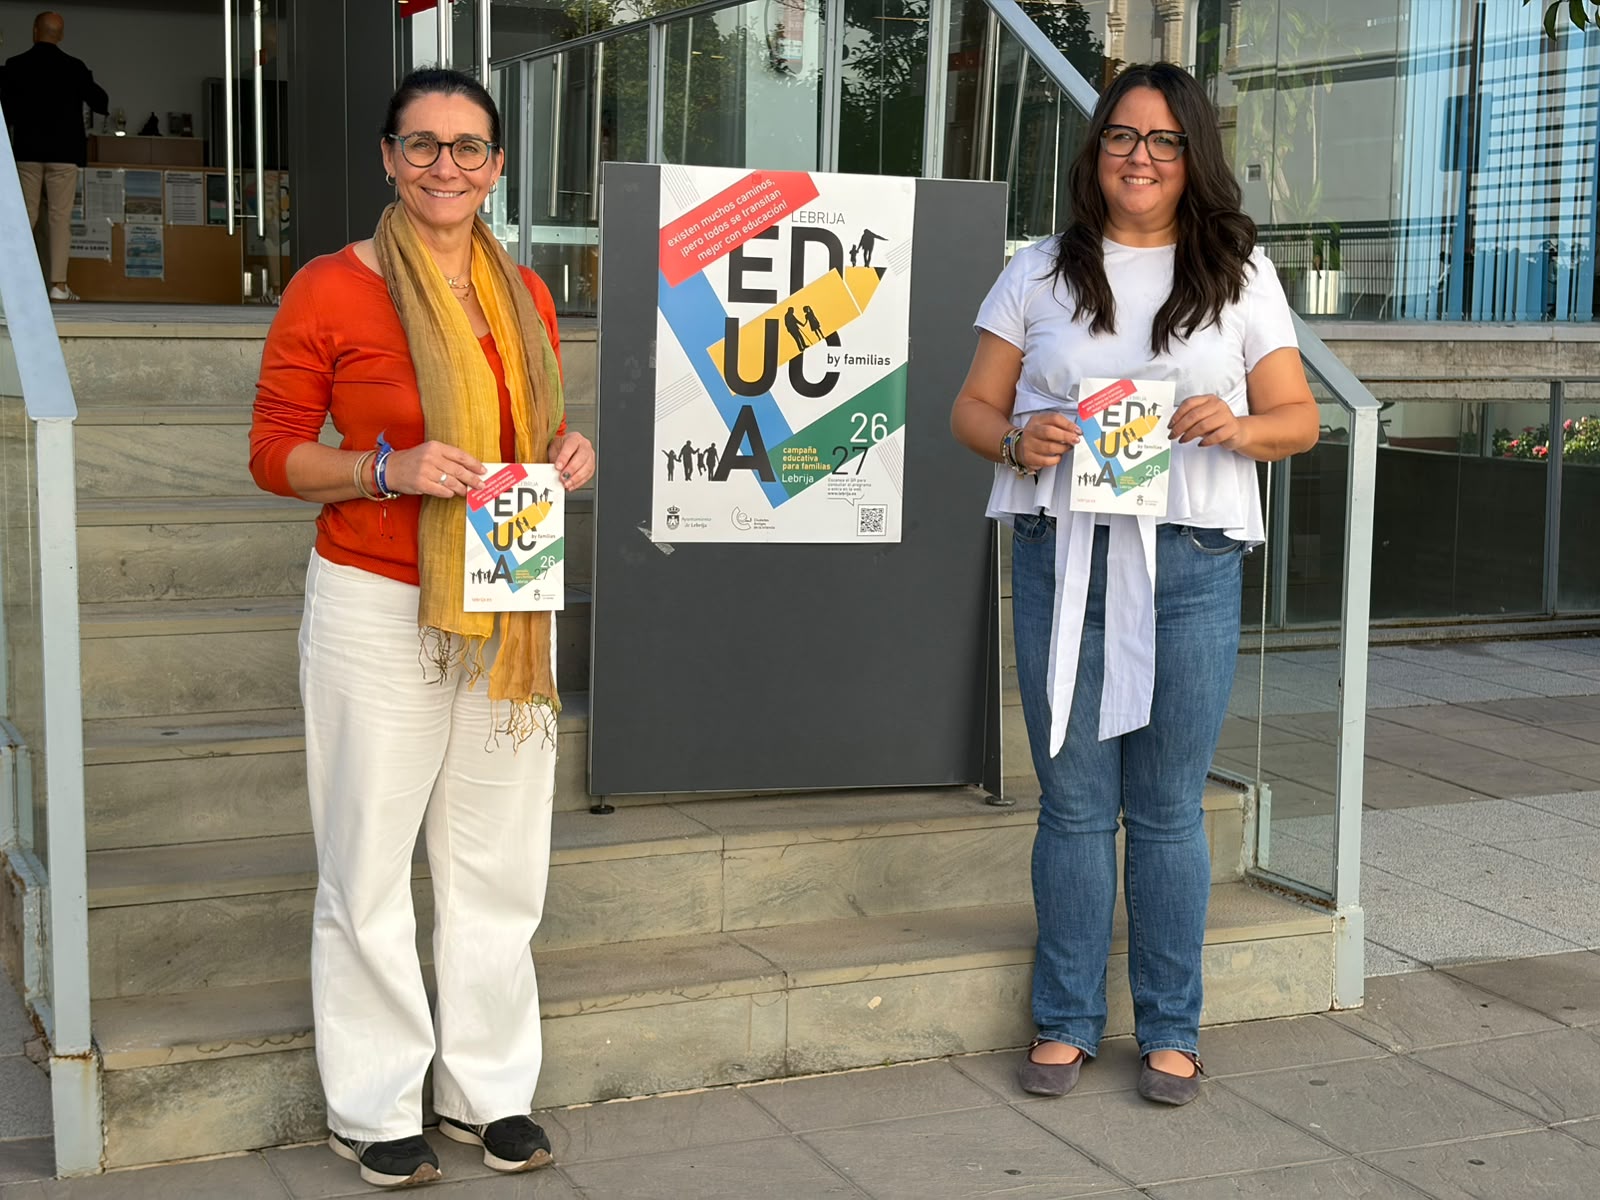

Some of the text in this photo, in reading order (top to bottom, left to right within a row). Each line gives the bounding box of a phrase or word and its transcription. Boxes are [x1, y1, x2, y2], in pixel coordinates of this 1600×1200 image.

[667, 178, 775, 247] existen muchos caminos,
[681, 190, 781, 257] ¡pero todos se transitan
[791, 211, 845, 224] LEBRIJA
[697, 200, 788, 261] mejor con educación!
[728, 225, 844, 304] ED
[724, 317, 842, 398] UC
[827, 353, 891, 367] by familias
[850, 412, 888, 443] 26
[1102, 401, 1145, 427] ED
[713, 405, 776, 482] A
[783, 446, 817, 455] campaña
[1100, 432, 1143, 459] UC
[832, 446, 869, 475] 27
[1095, 461, 1117, 488] A
[1146, 465, 1160, 476] 26
[782, 474, 814, 485] Lebrija
[1138, 476, 1153, 487] 27
[494, 487, 537, 516] ED
[493, 522, 537, 551] UC
[490, 554, 514, 584] A
[534, 568, 548, 580] 27
[540, 556, 555, 568] 26
